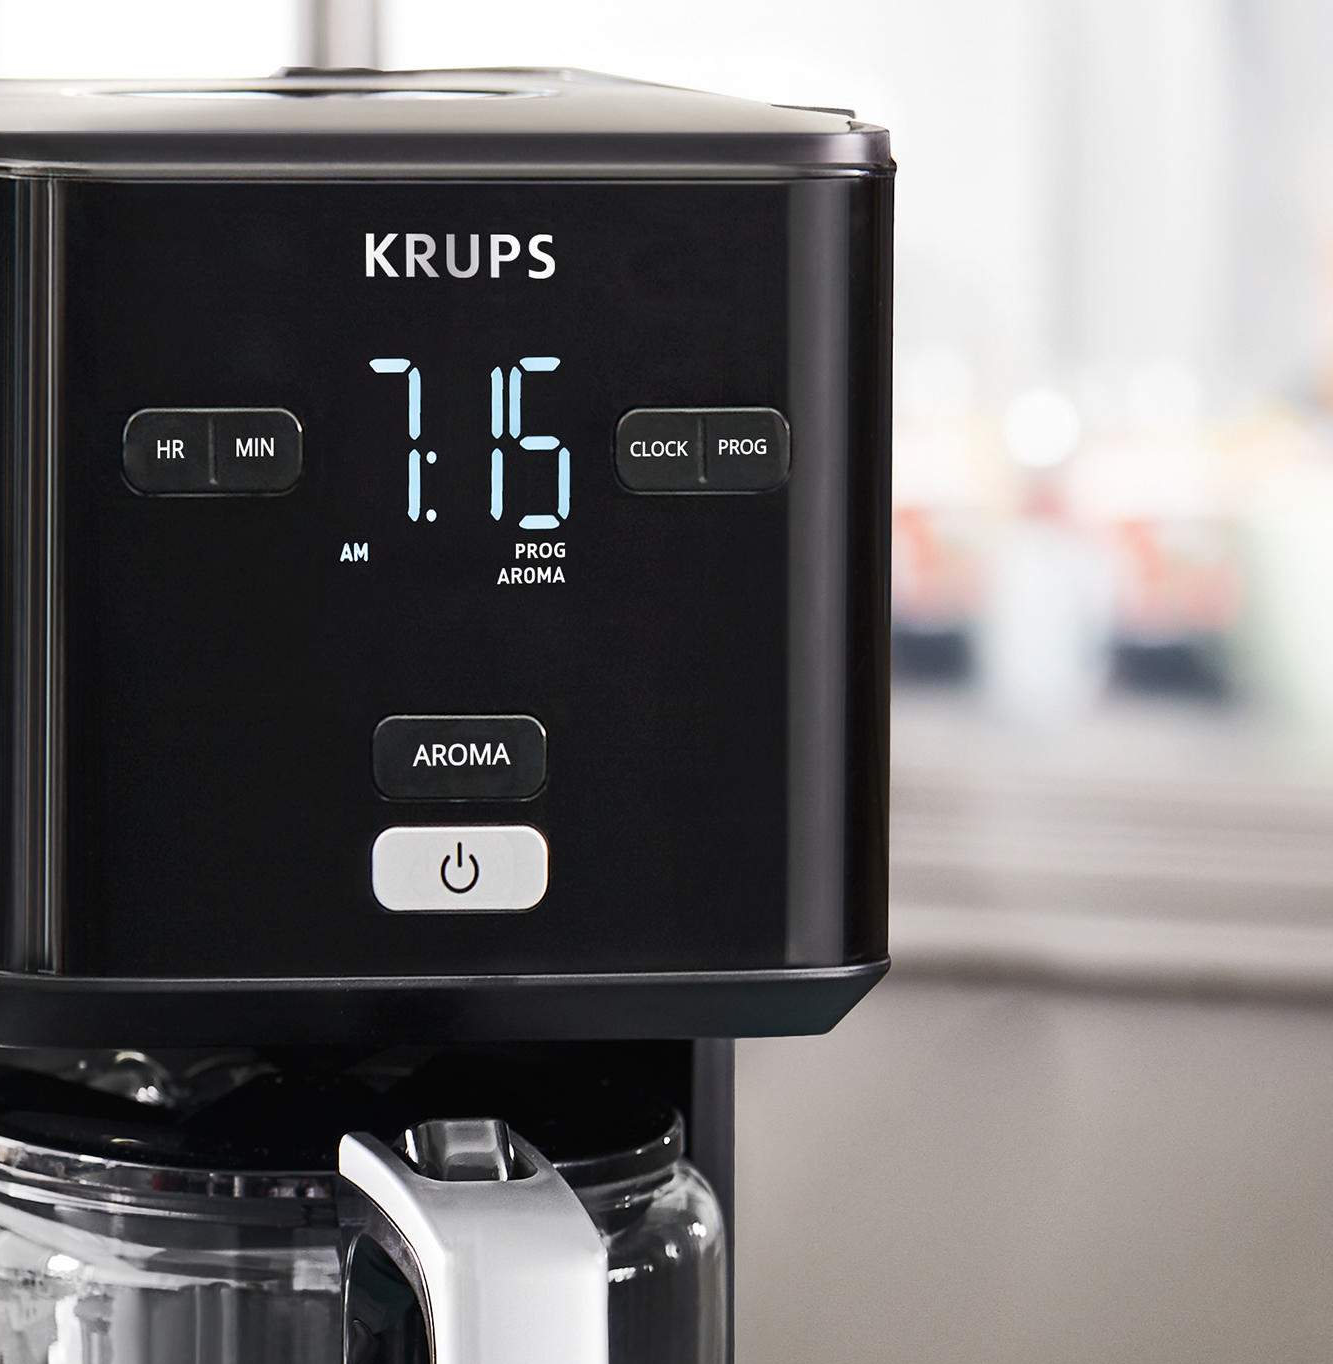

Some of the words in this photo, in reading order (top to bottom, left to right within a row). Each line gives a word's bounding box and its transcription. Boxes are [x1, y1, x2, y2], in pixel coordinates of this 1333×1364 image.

[365, 232, 556, 280] KRUPS
[155, 439, 186, 460] HR
[234, 437, 276, 458] MIN
[368, 356, 571, 530] 7:15
[629, 440, 689, 458] CLOCK
[717, 438, 768, 457] PROG
[339, 542, 369, 563] AM
[515, 542, 567, 560] PROG
[496, 565, 566, 585] AROMA
[412, 742, 512, 767] AROMA
